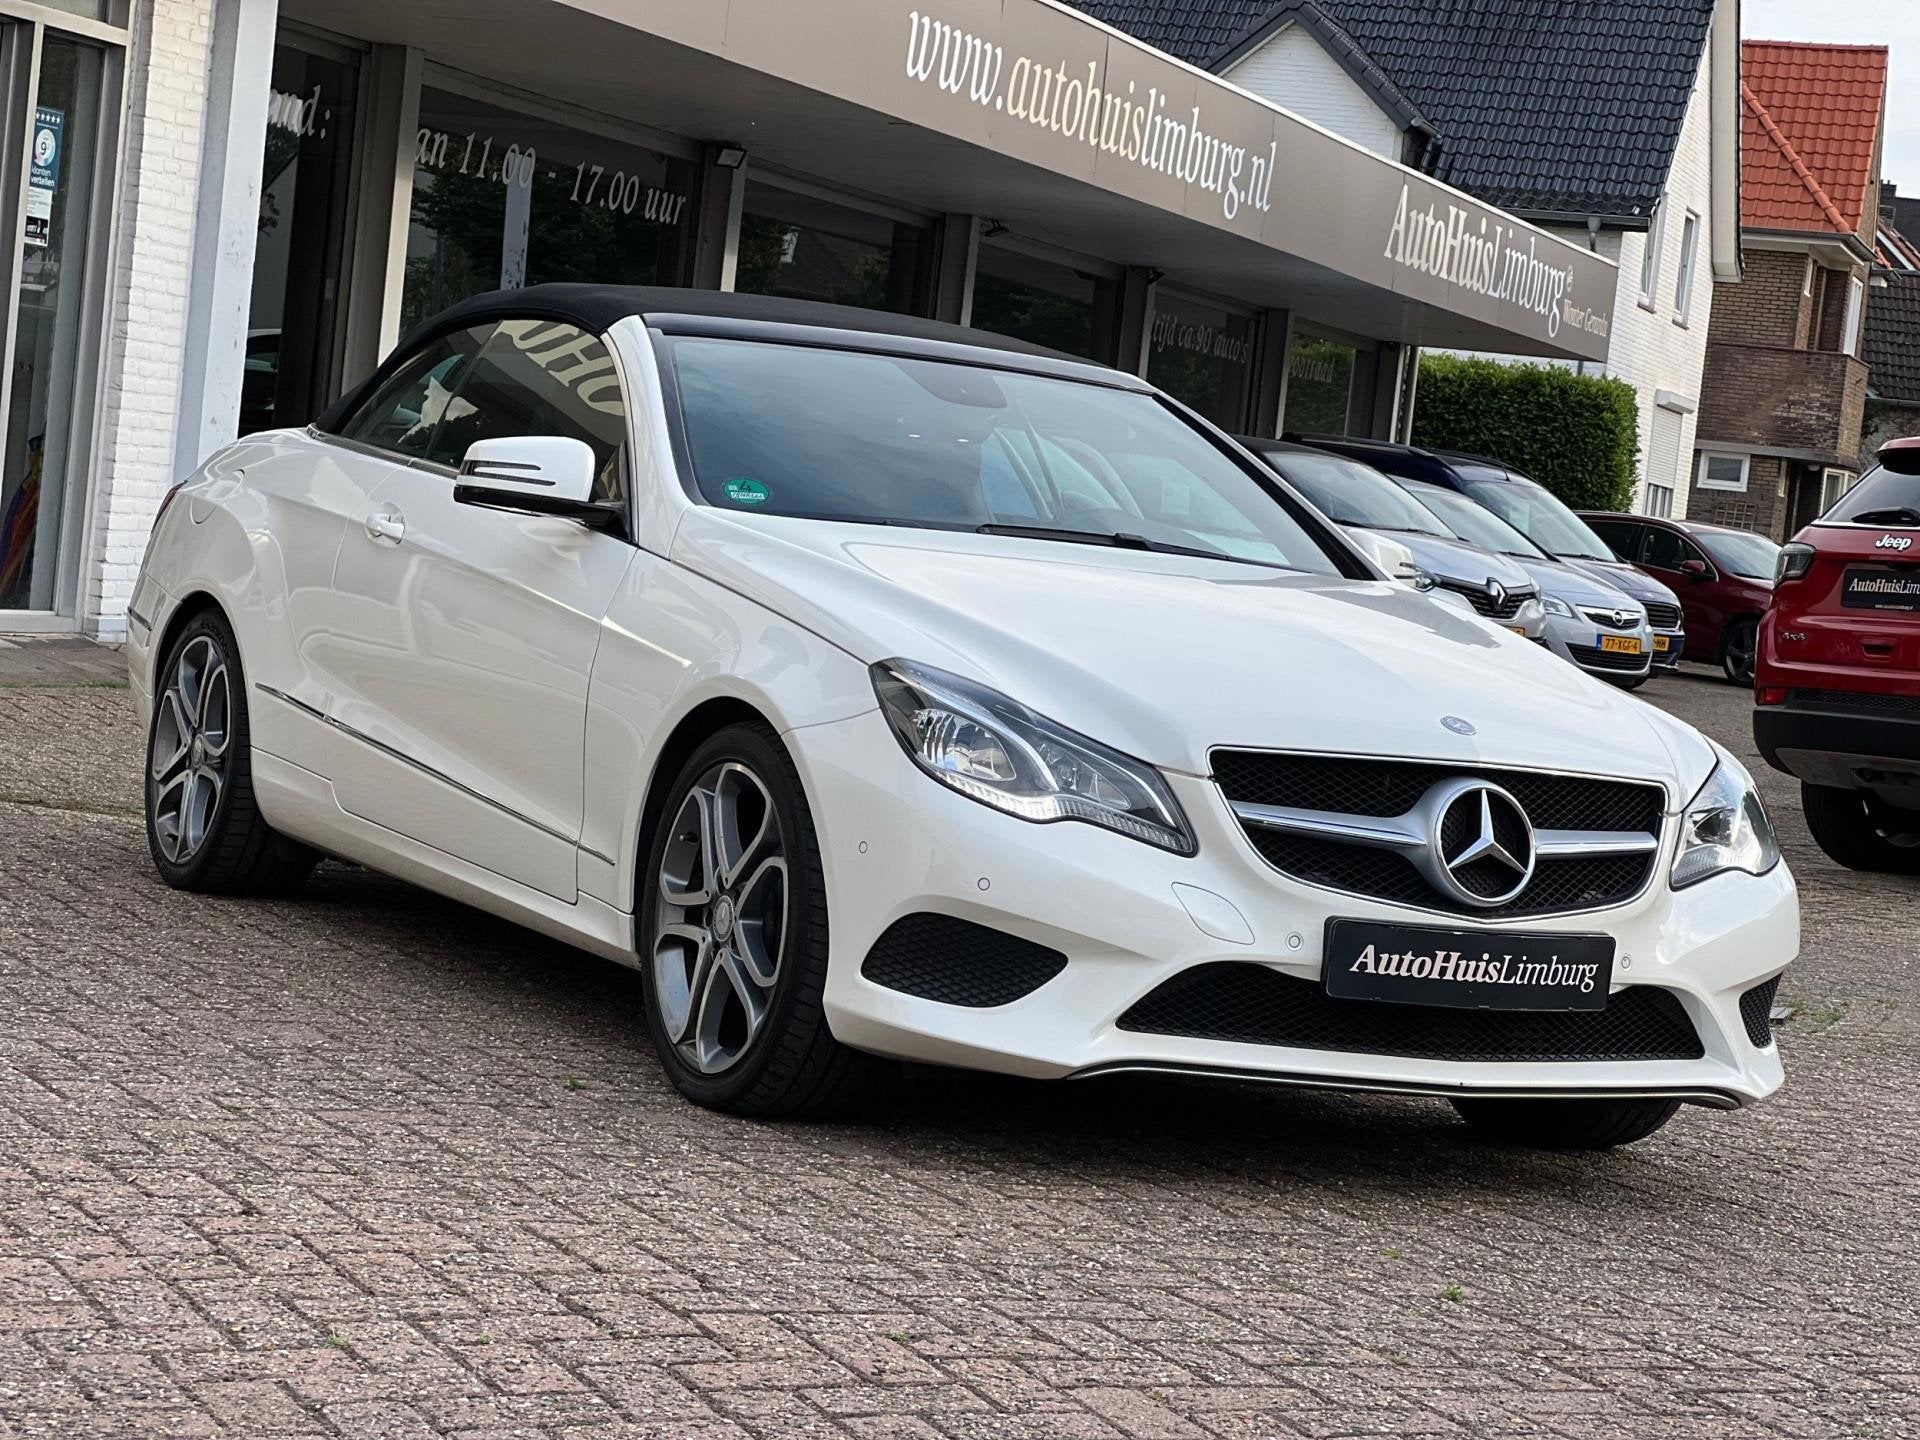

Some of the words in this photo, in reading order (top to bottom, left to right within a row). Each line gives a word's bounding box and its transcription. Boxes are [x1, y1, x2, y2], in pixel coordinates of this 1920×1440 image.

[906, 11, 1277, 219] www.autohuislimburg.nl
[459, 132, 536, 188] 11.00
[570, 161, 639, 215] 17.00
[644, 187, 686, 225] uur
[1875, 534, 1912, 551] Jeep
[1349, 944, 1599, 993] AutoHuisLimburg
